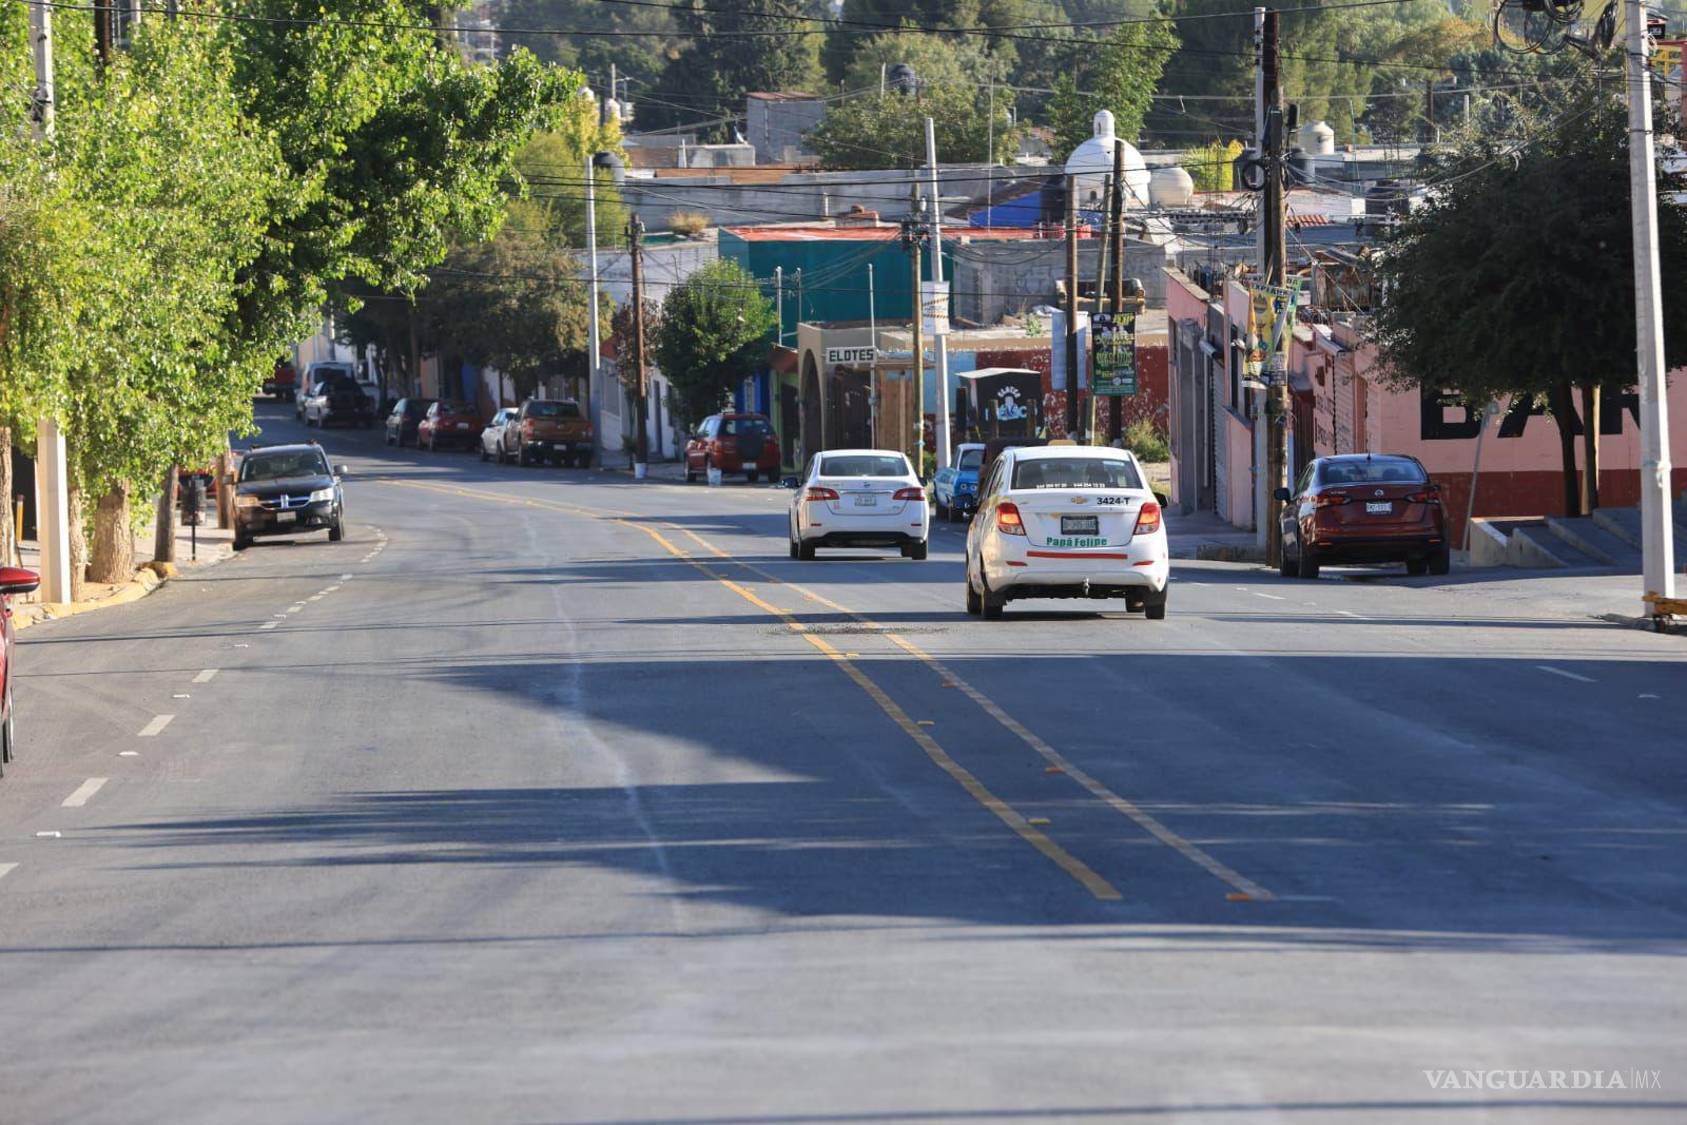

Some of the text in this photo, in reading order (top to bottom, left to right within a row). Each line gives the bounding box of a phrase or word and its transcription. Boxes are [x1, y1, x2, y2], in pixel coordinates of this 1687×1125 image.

[829, 349, 874, 362] ELOTES
[1097, 497, 1131, 506] 3424-T
[1046, 536, 1108, 547] Papá Felipe
